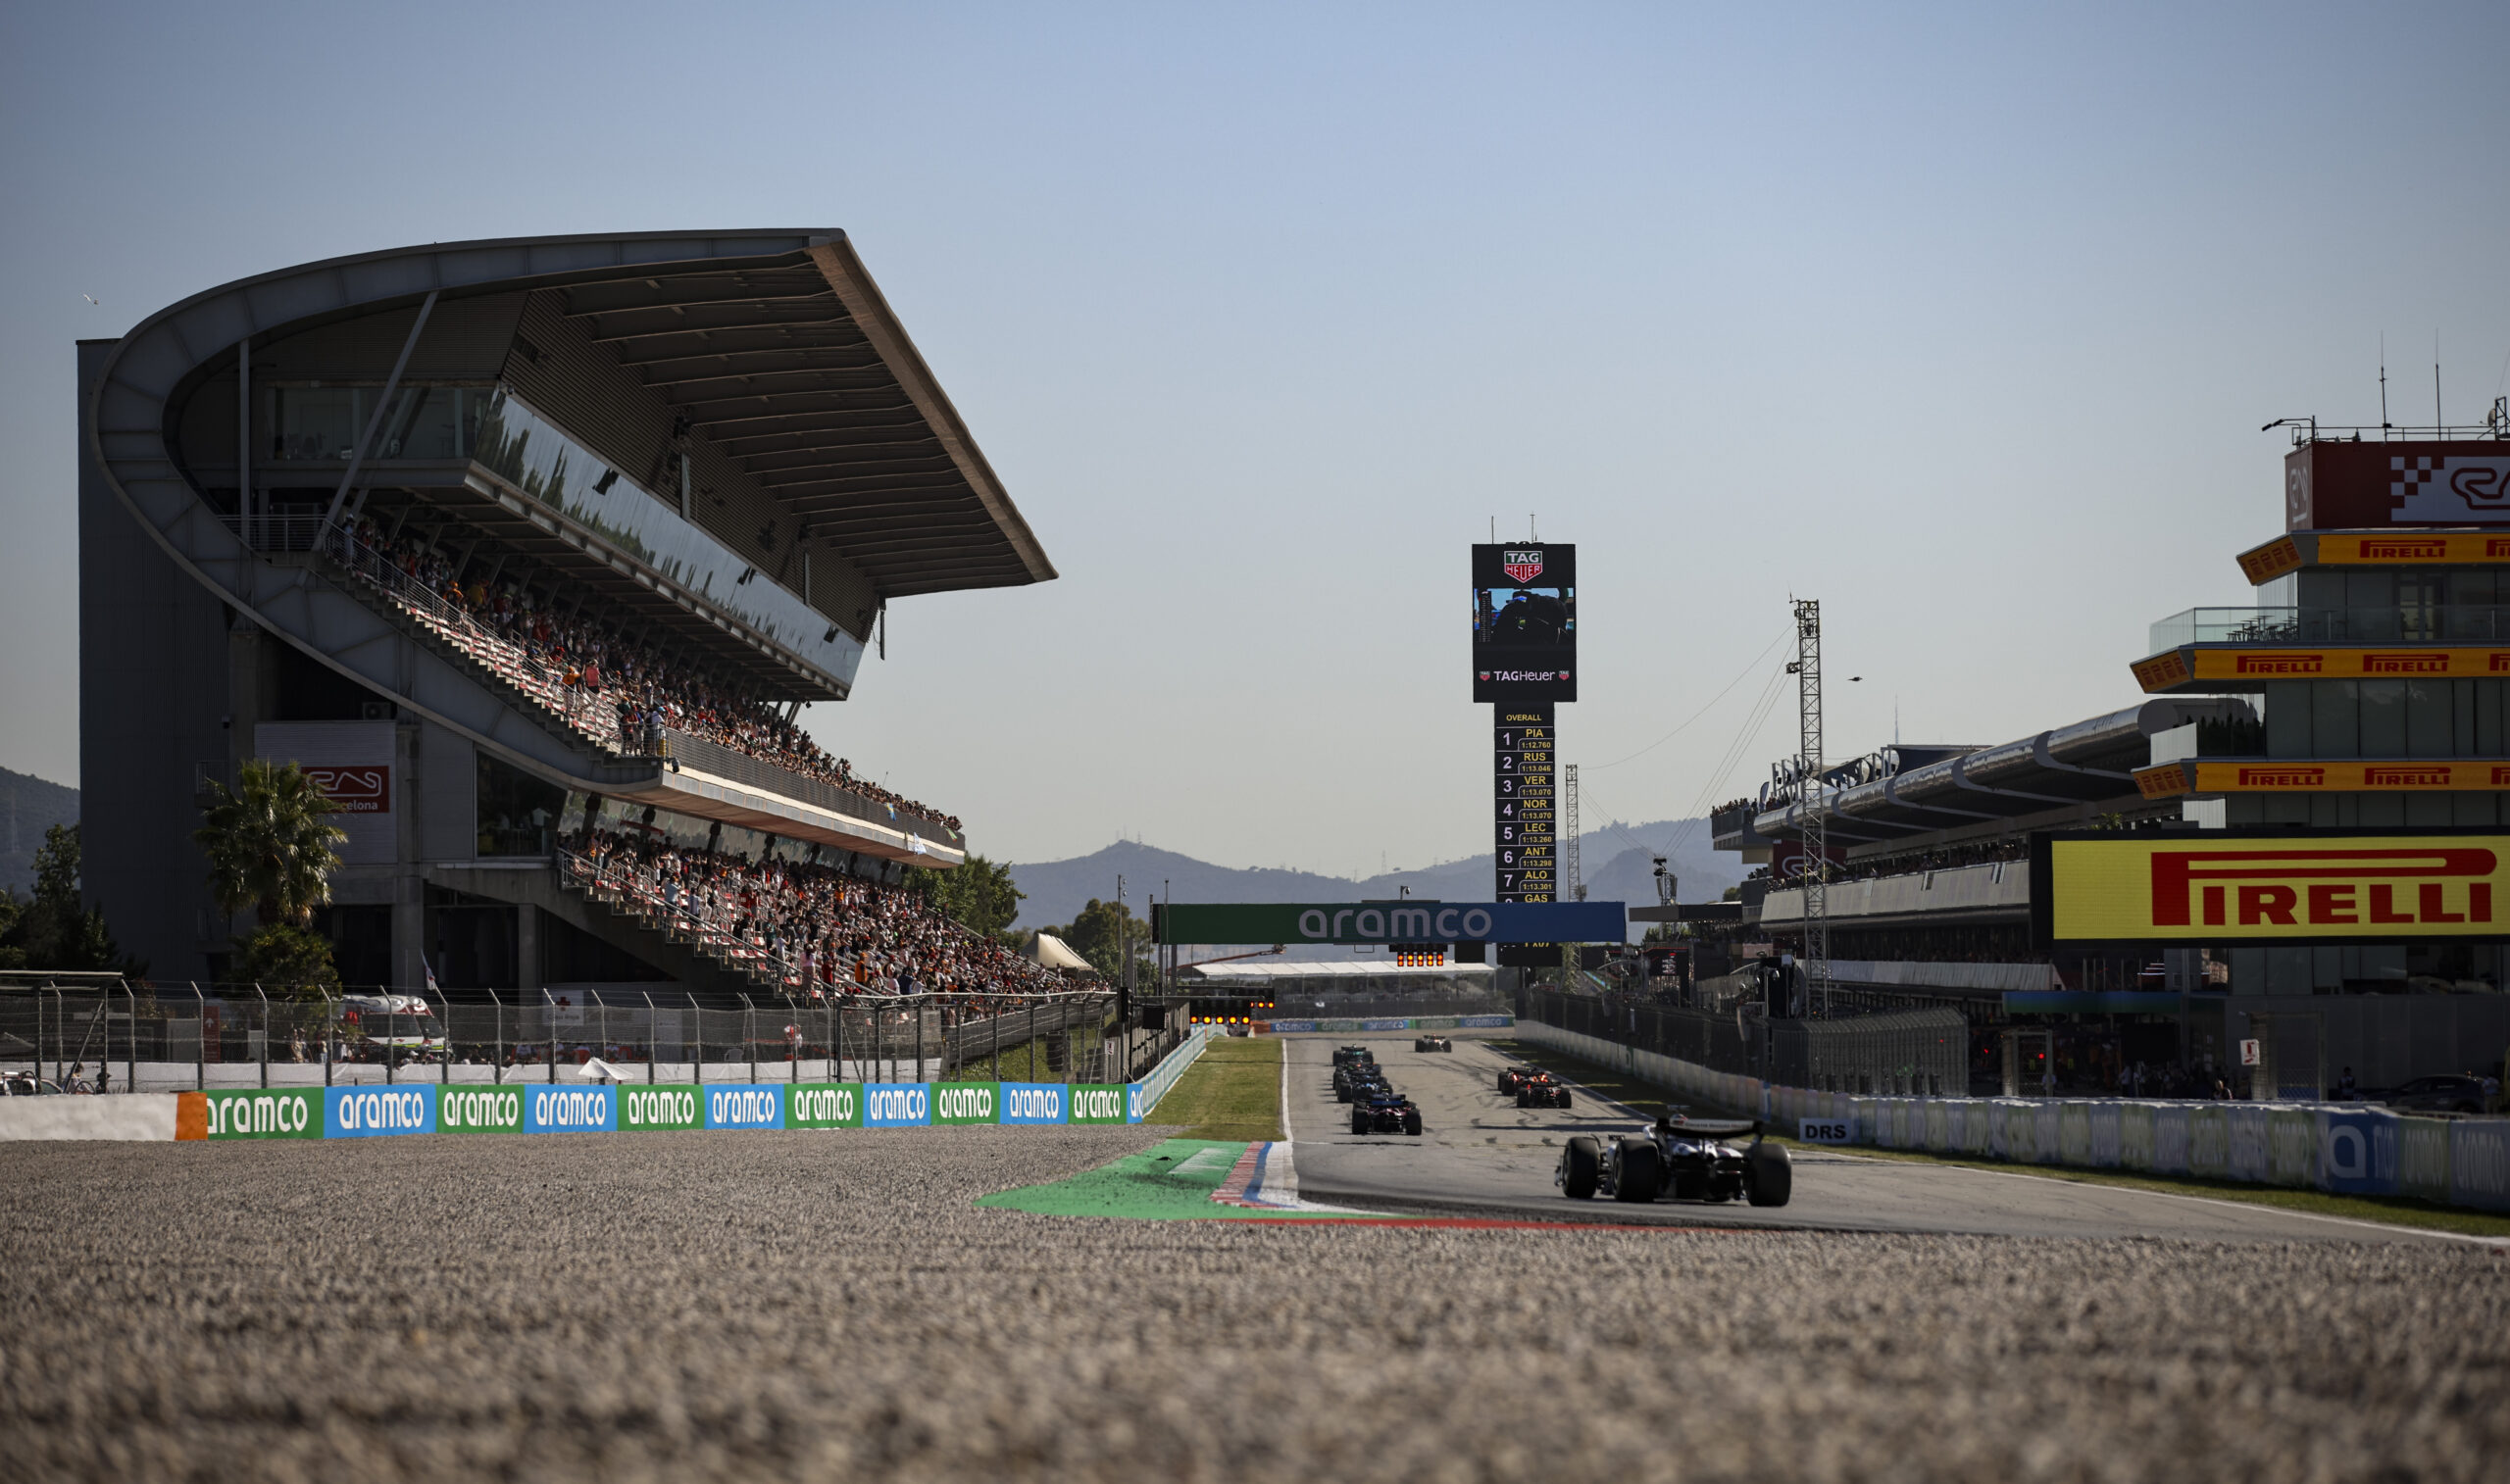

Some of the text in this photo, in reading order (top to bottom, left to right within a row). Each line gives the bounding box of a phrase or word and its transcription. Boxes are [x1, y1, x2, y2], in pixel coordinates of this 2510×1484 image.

[2359, 539, 2446, 558] PIRELLI
[1507, 553, 1539, 564] TAG
[1506, 566, 1540, 580] HEUER
[2236, 655, 2324, 673] PIRELLI
[2363, 654, 2449, 672] PIRELLI
[1503, 732, 1511, 745] 1
[1526, 728, 1544, 737] PIA
[1503, 756, 1512, 768] 2
[1524, 752, 1546, 761] RUS
[1524, 775, 1546, 784] VER
[2238, 767, 2325, 786] PIRELLI
[2364, 767, 2451, 785] PIRELLI
[1503, 779, 1512, 792] 3
[1503, 803, 1513, 816] 4
[1523, 799, 1547, 808] NOR
[1504, 826, 1513, 839] 5
[1525, 822, 1546, 832] LEC
[1504, 851, 1513, 864] 6
[1525, 847, 1547, 856] ANT
[1504, 874, 1513, 887] 7
[1525, 870, 1548, 879] ALO
[2151, 849, 2497, 926] PIRELLI
[1525, 894, 1548, 903] GAS
[1299, 909, 1492, 938] aramco
[1466, 1018, 1502, 1027] aramco
[444, 1092, 519, 1126] aramco
[536, 1092, 606, 1125] aramco
[628, 1091, 694, 1124] aramco
[713, 1091, 775, 1123] aramco
[795, 1090, 853, 1120] aramco
[871, 1090, 926, 1120] aramco
[939, 1088, 991, 1117] aramco
[1010, 1089, 1059, 1118] aramco
[1075, 1090, 1120, 1118] aramco
[207, 1096, 308, 1134] aramco
[339, 1092, 424, 1129] aramco
[1805, 1124, 1846, 1139] DRS
